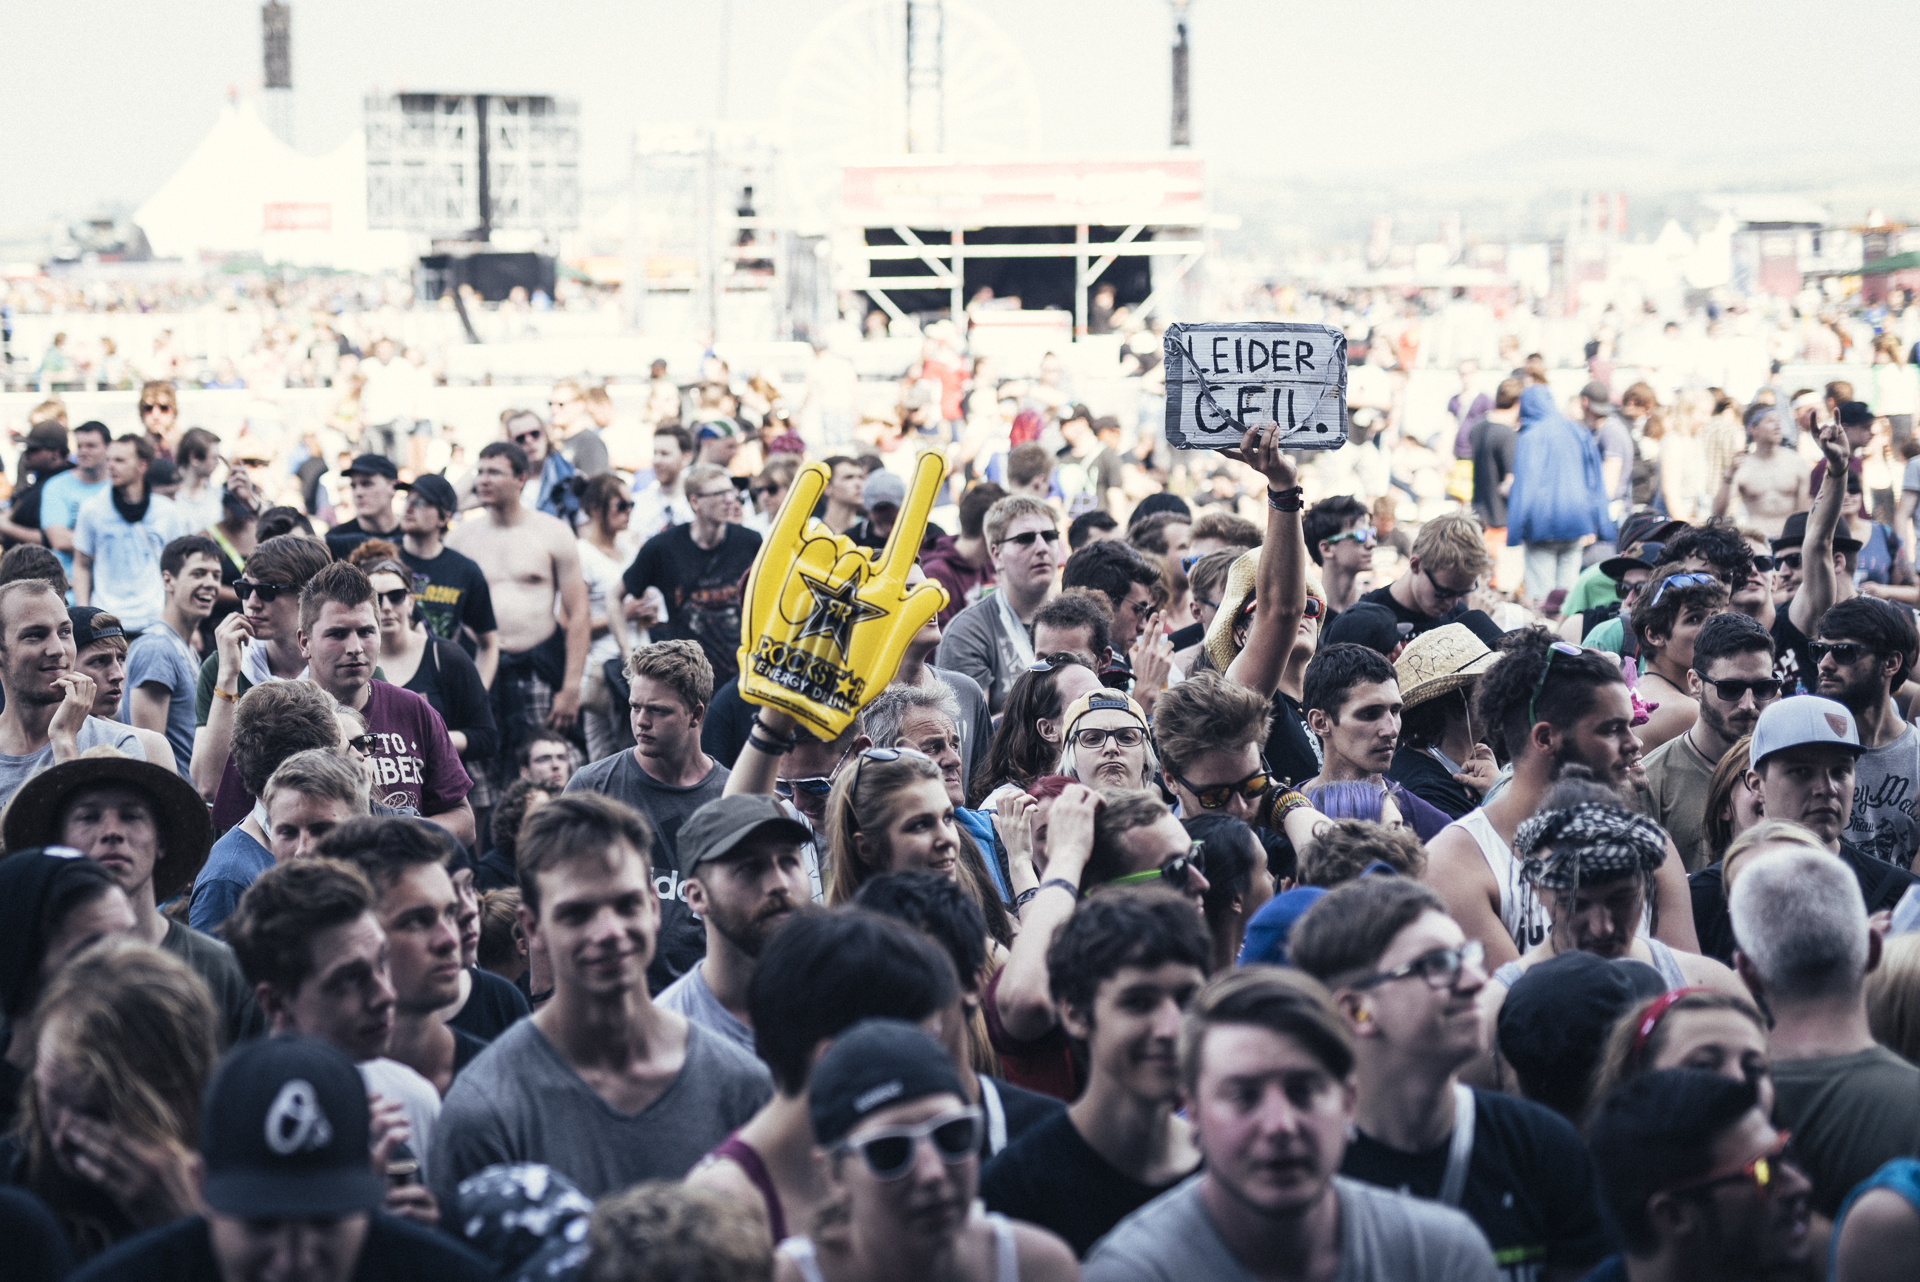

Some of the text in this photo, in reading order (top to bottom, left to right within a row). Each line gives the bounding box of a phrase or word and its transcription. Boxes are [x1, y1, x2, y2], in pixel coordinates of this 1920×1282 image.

[1188, 335, 1315, 376] LEIDER
[756, 661, 810, 692] ENERGY
[812, 686, 851, 715] DRINK
[376, 733, 407, 754] TO
